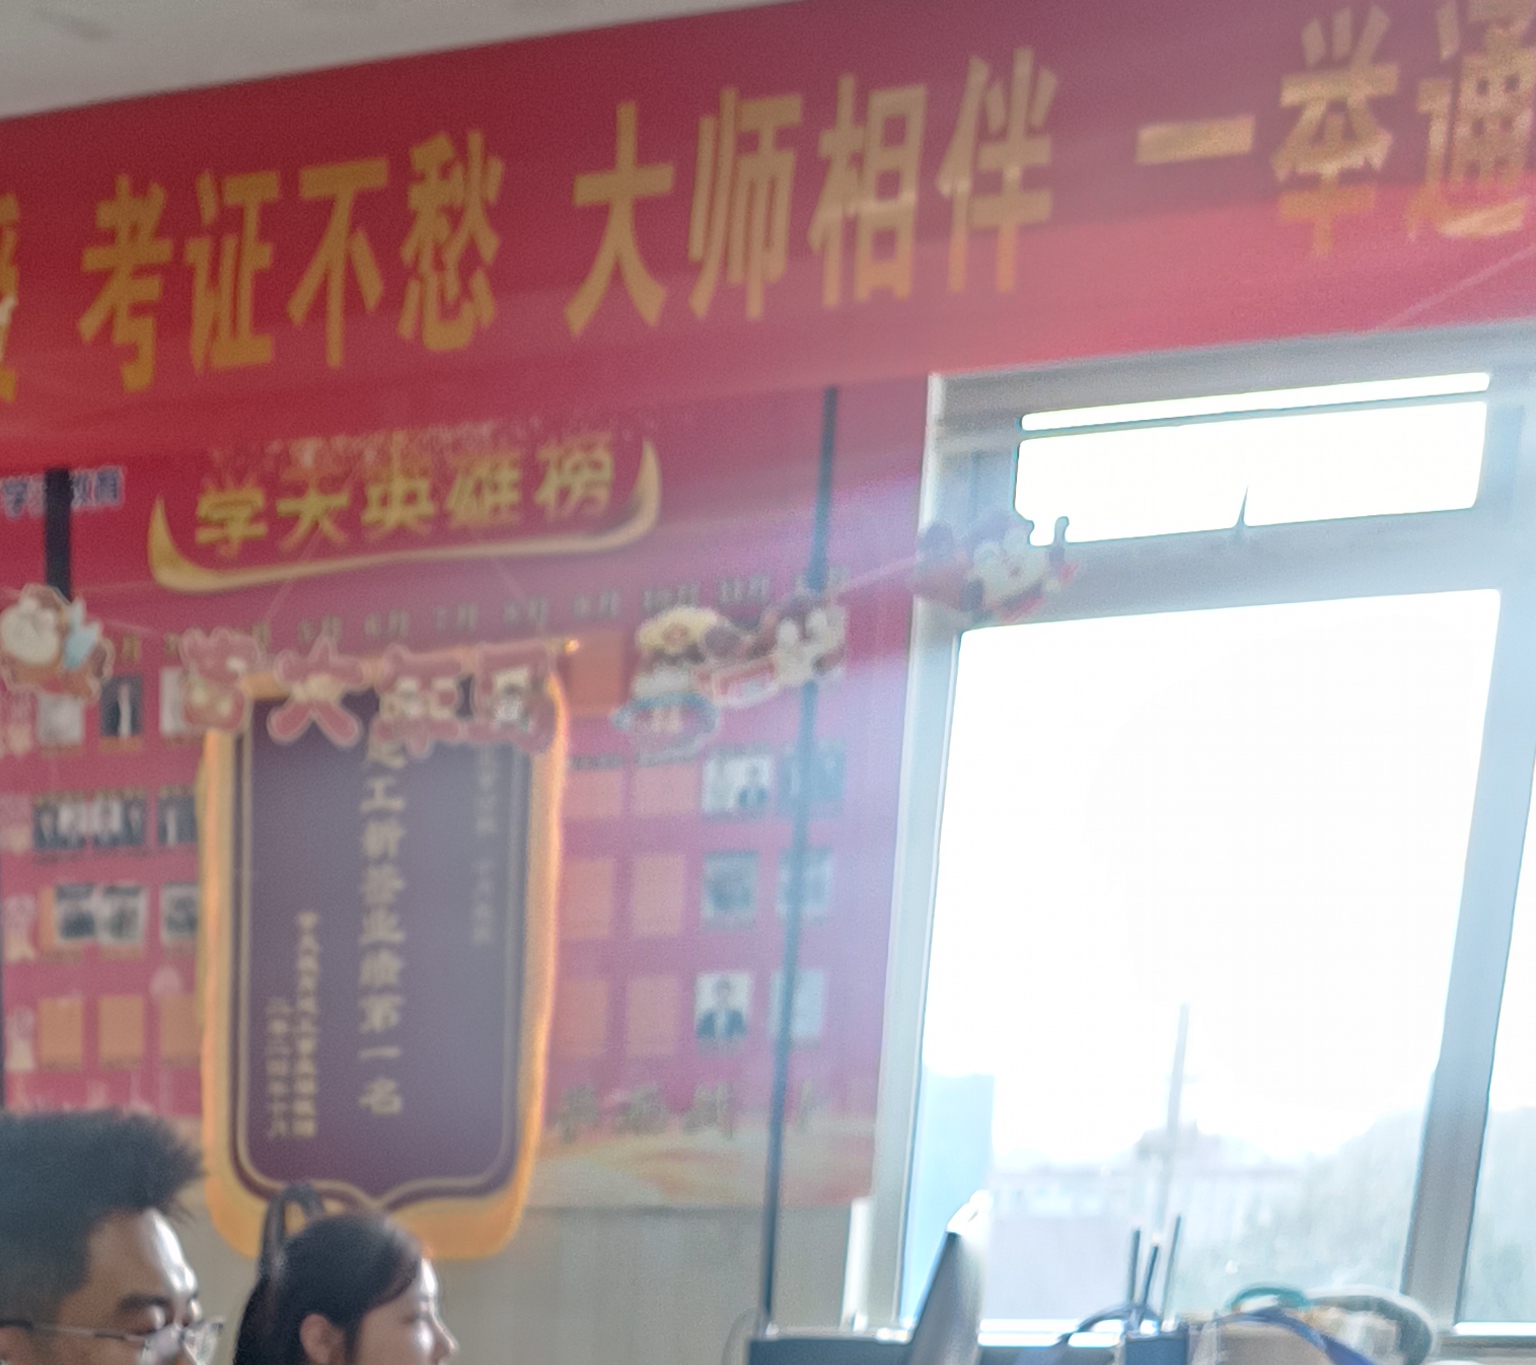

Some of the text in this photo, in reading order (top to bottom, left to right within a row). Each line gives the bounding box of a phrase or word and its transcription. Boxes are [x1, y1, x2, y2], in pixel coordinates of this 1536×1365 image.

[77, 130, 505, 393] 考证不愁
[562, 45, 1059, 339] 大师相伴
[1134, 0, 1536, 259] 一举通
